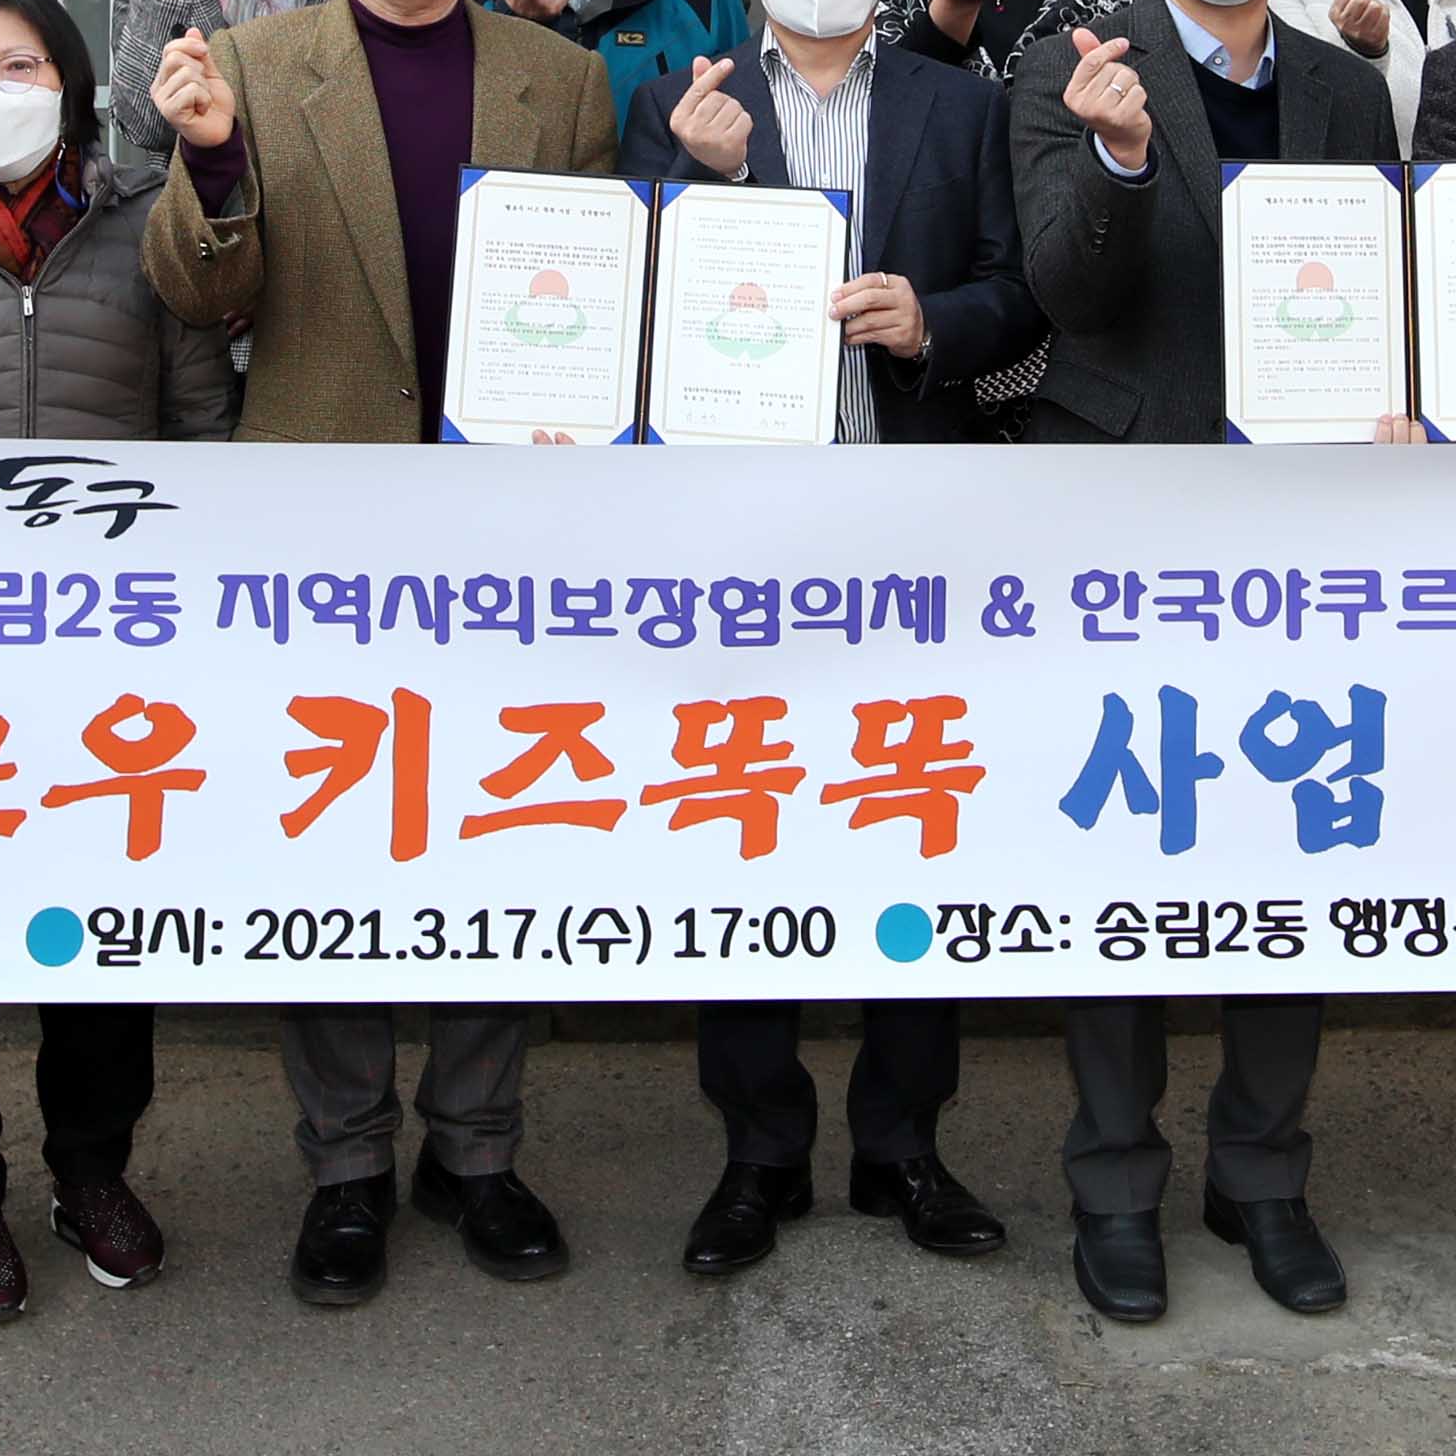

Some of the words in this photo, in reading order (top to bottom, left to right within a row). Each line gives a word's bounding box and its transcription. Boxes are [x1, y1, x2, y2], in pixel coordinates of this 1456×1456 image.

[617, 32, 645, 44] K2
[216, 571, 948, 649] 지역사회보장협의체
[980, 574, 1037, 638] &
[278, 686, 987, 863] 키즈똑똑
[1058, 683, 1389, 857] 사업
[85, 905, 225, 968] 일시:
[244, 902, 652, 967] 2021.3.17.(수)
[673, 905, 836, 961] 17:00
[935, 901, 1073, 964] 장소:
[1093, 898, 1308, 962] 송림2동
